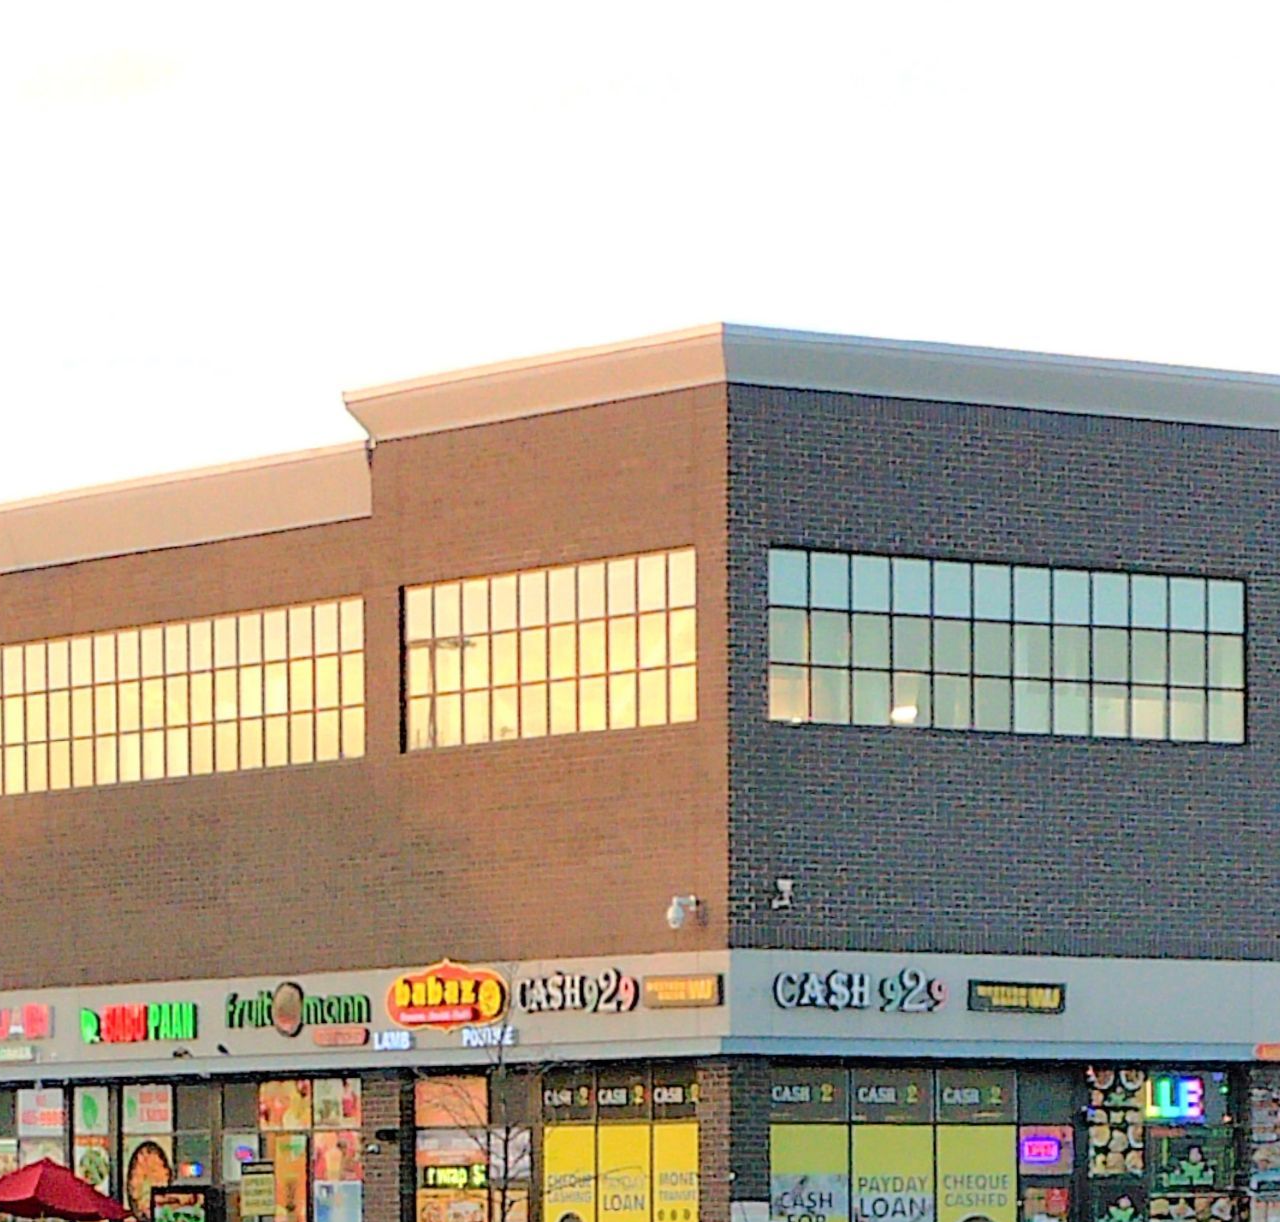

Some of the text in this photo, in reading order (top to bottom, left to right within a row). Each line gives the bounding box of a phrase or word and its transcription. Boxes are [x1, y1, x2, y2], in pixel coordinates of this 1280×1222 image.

[394, 975, 476, 1008] babaz
[517, 967, 637, 1013] CASH 929
[774, 967, 948, 1012] CASH 929
[148, 1002, 196, 1041] PAAN
[374, 1031, 411, 1050] LAMB
[772, 1084, 810, 1103] CASH
[858, 1085, 898, 1104] CASH
[943, 1086, 980, 1104] CASH
[858, 1176, 929, 1194] PAYDAY
[943, 1174, 1009, 1191] CHEQUE
[603, 1195, 645, 1211] LOAN
[782, 1191, 833, 1210] CASH
[860, 1197, 926, 1219] LOAN
